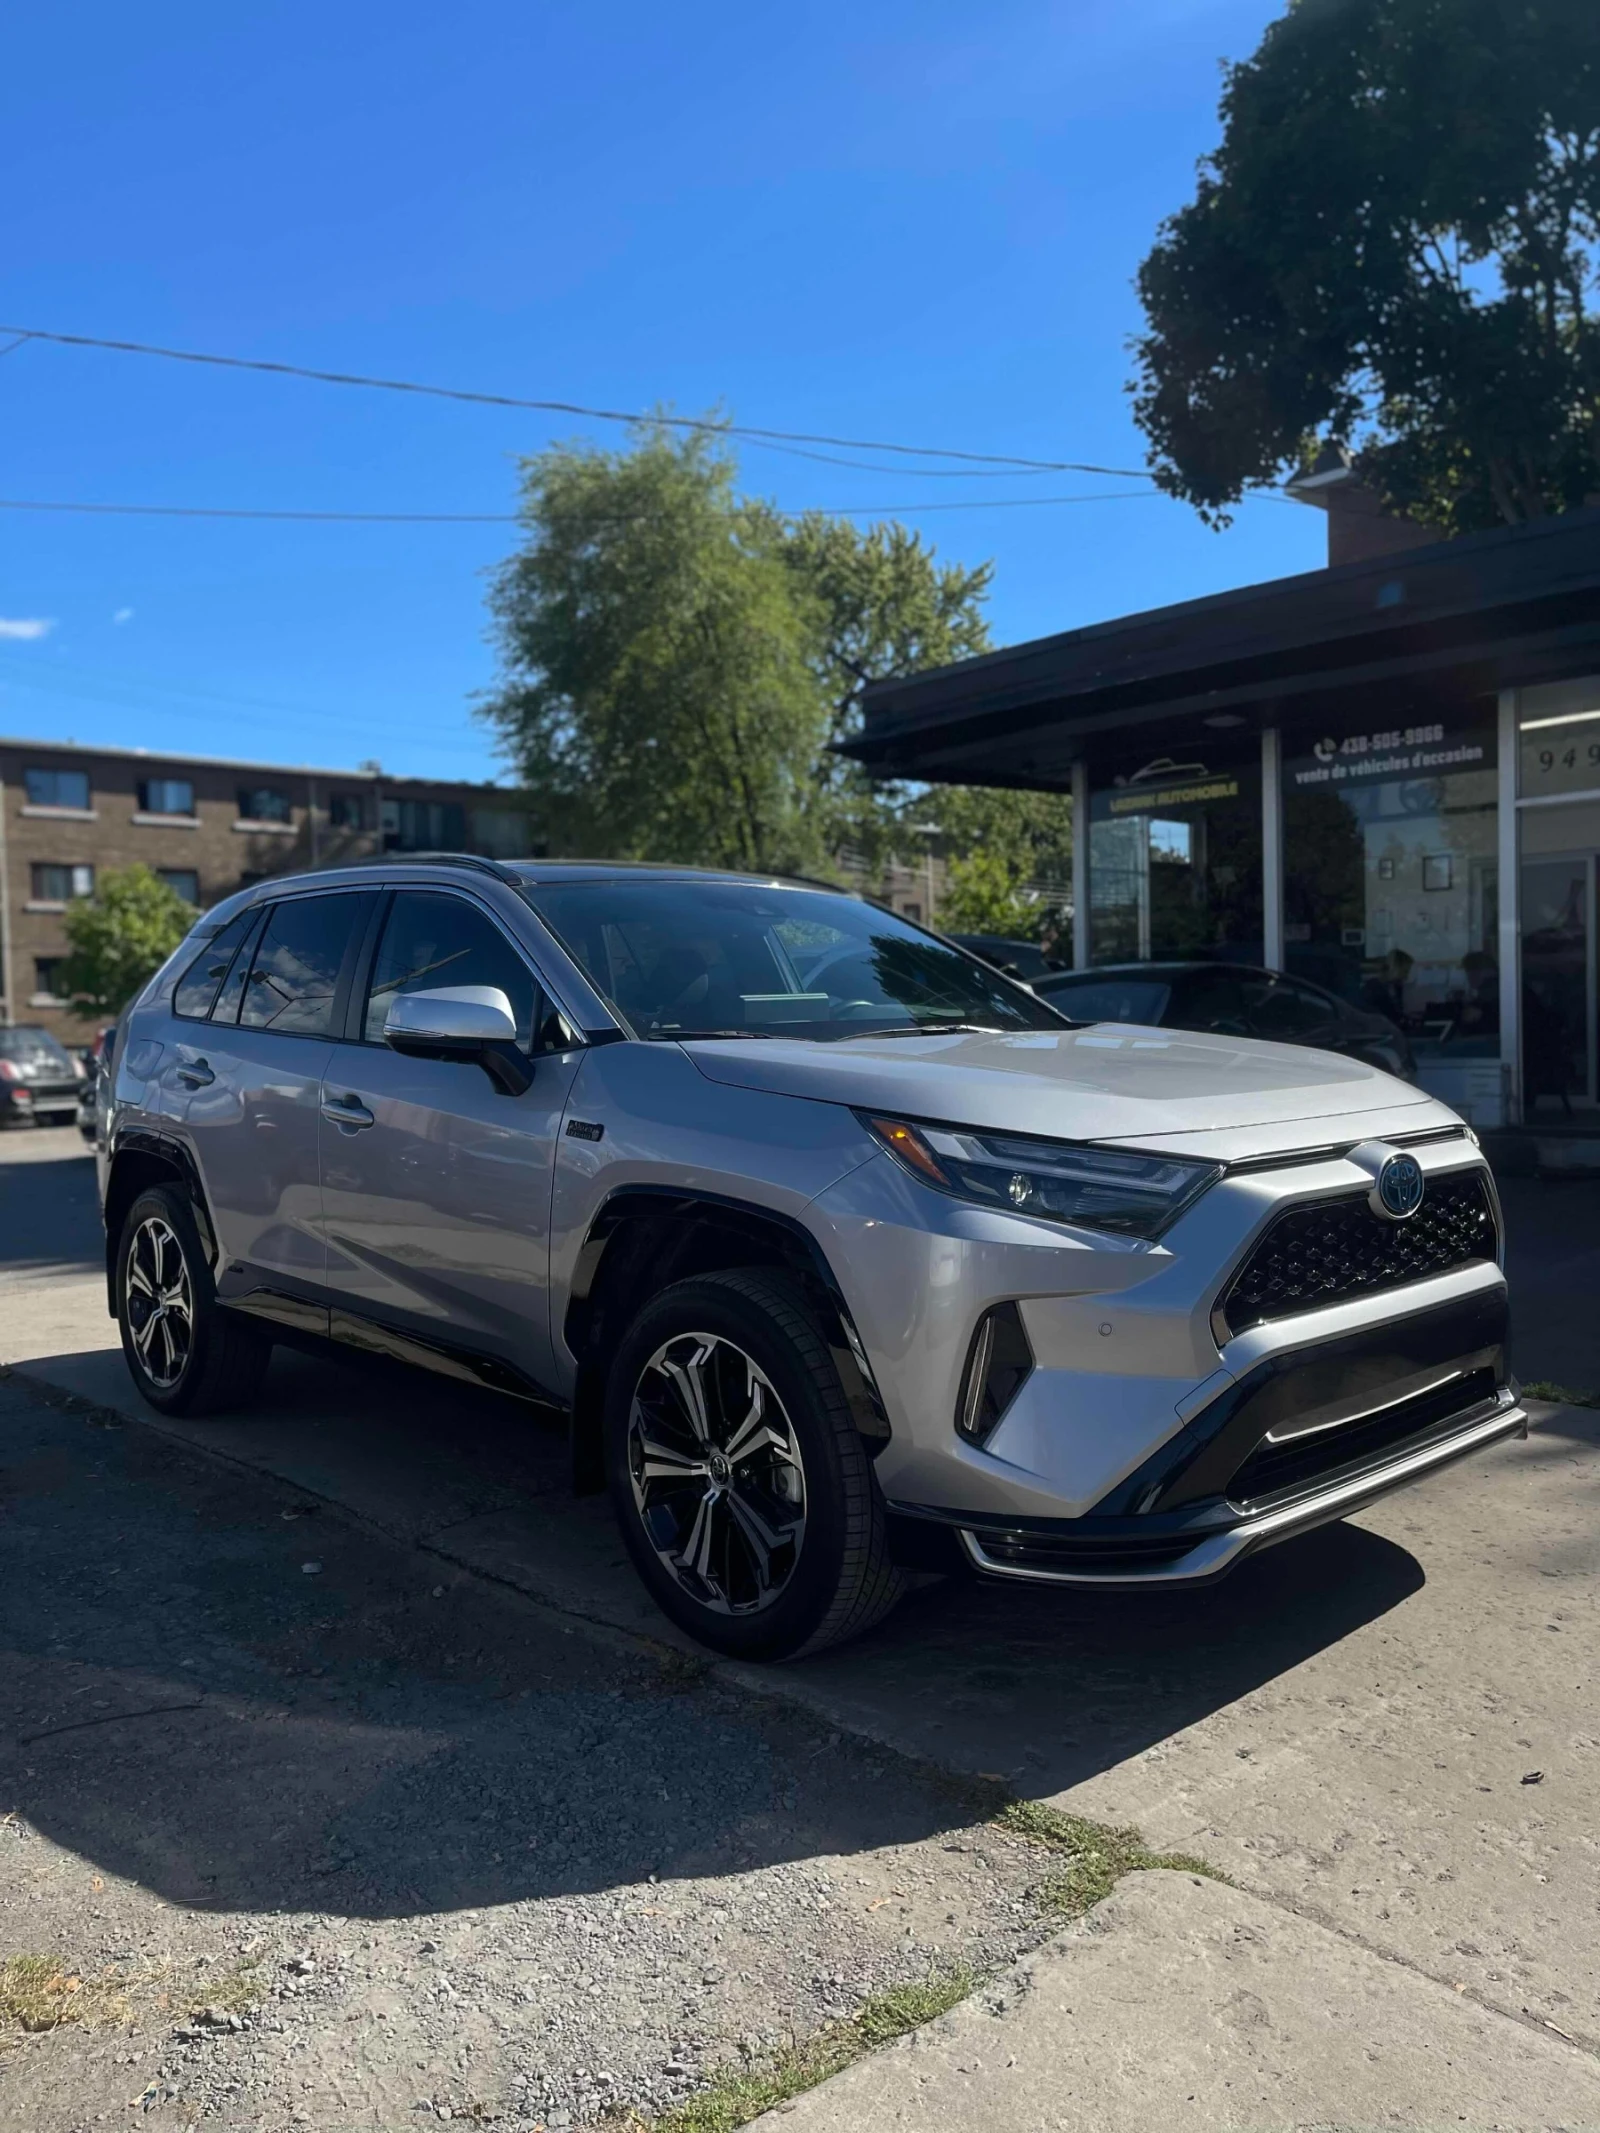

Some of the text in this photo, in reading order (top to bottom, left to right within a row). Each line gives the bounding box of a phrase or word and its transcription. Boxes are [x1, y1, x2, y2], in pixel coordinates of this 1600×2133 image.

[1295, 745, 1483, 785] vente de véhicules d'occasion
